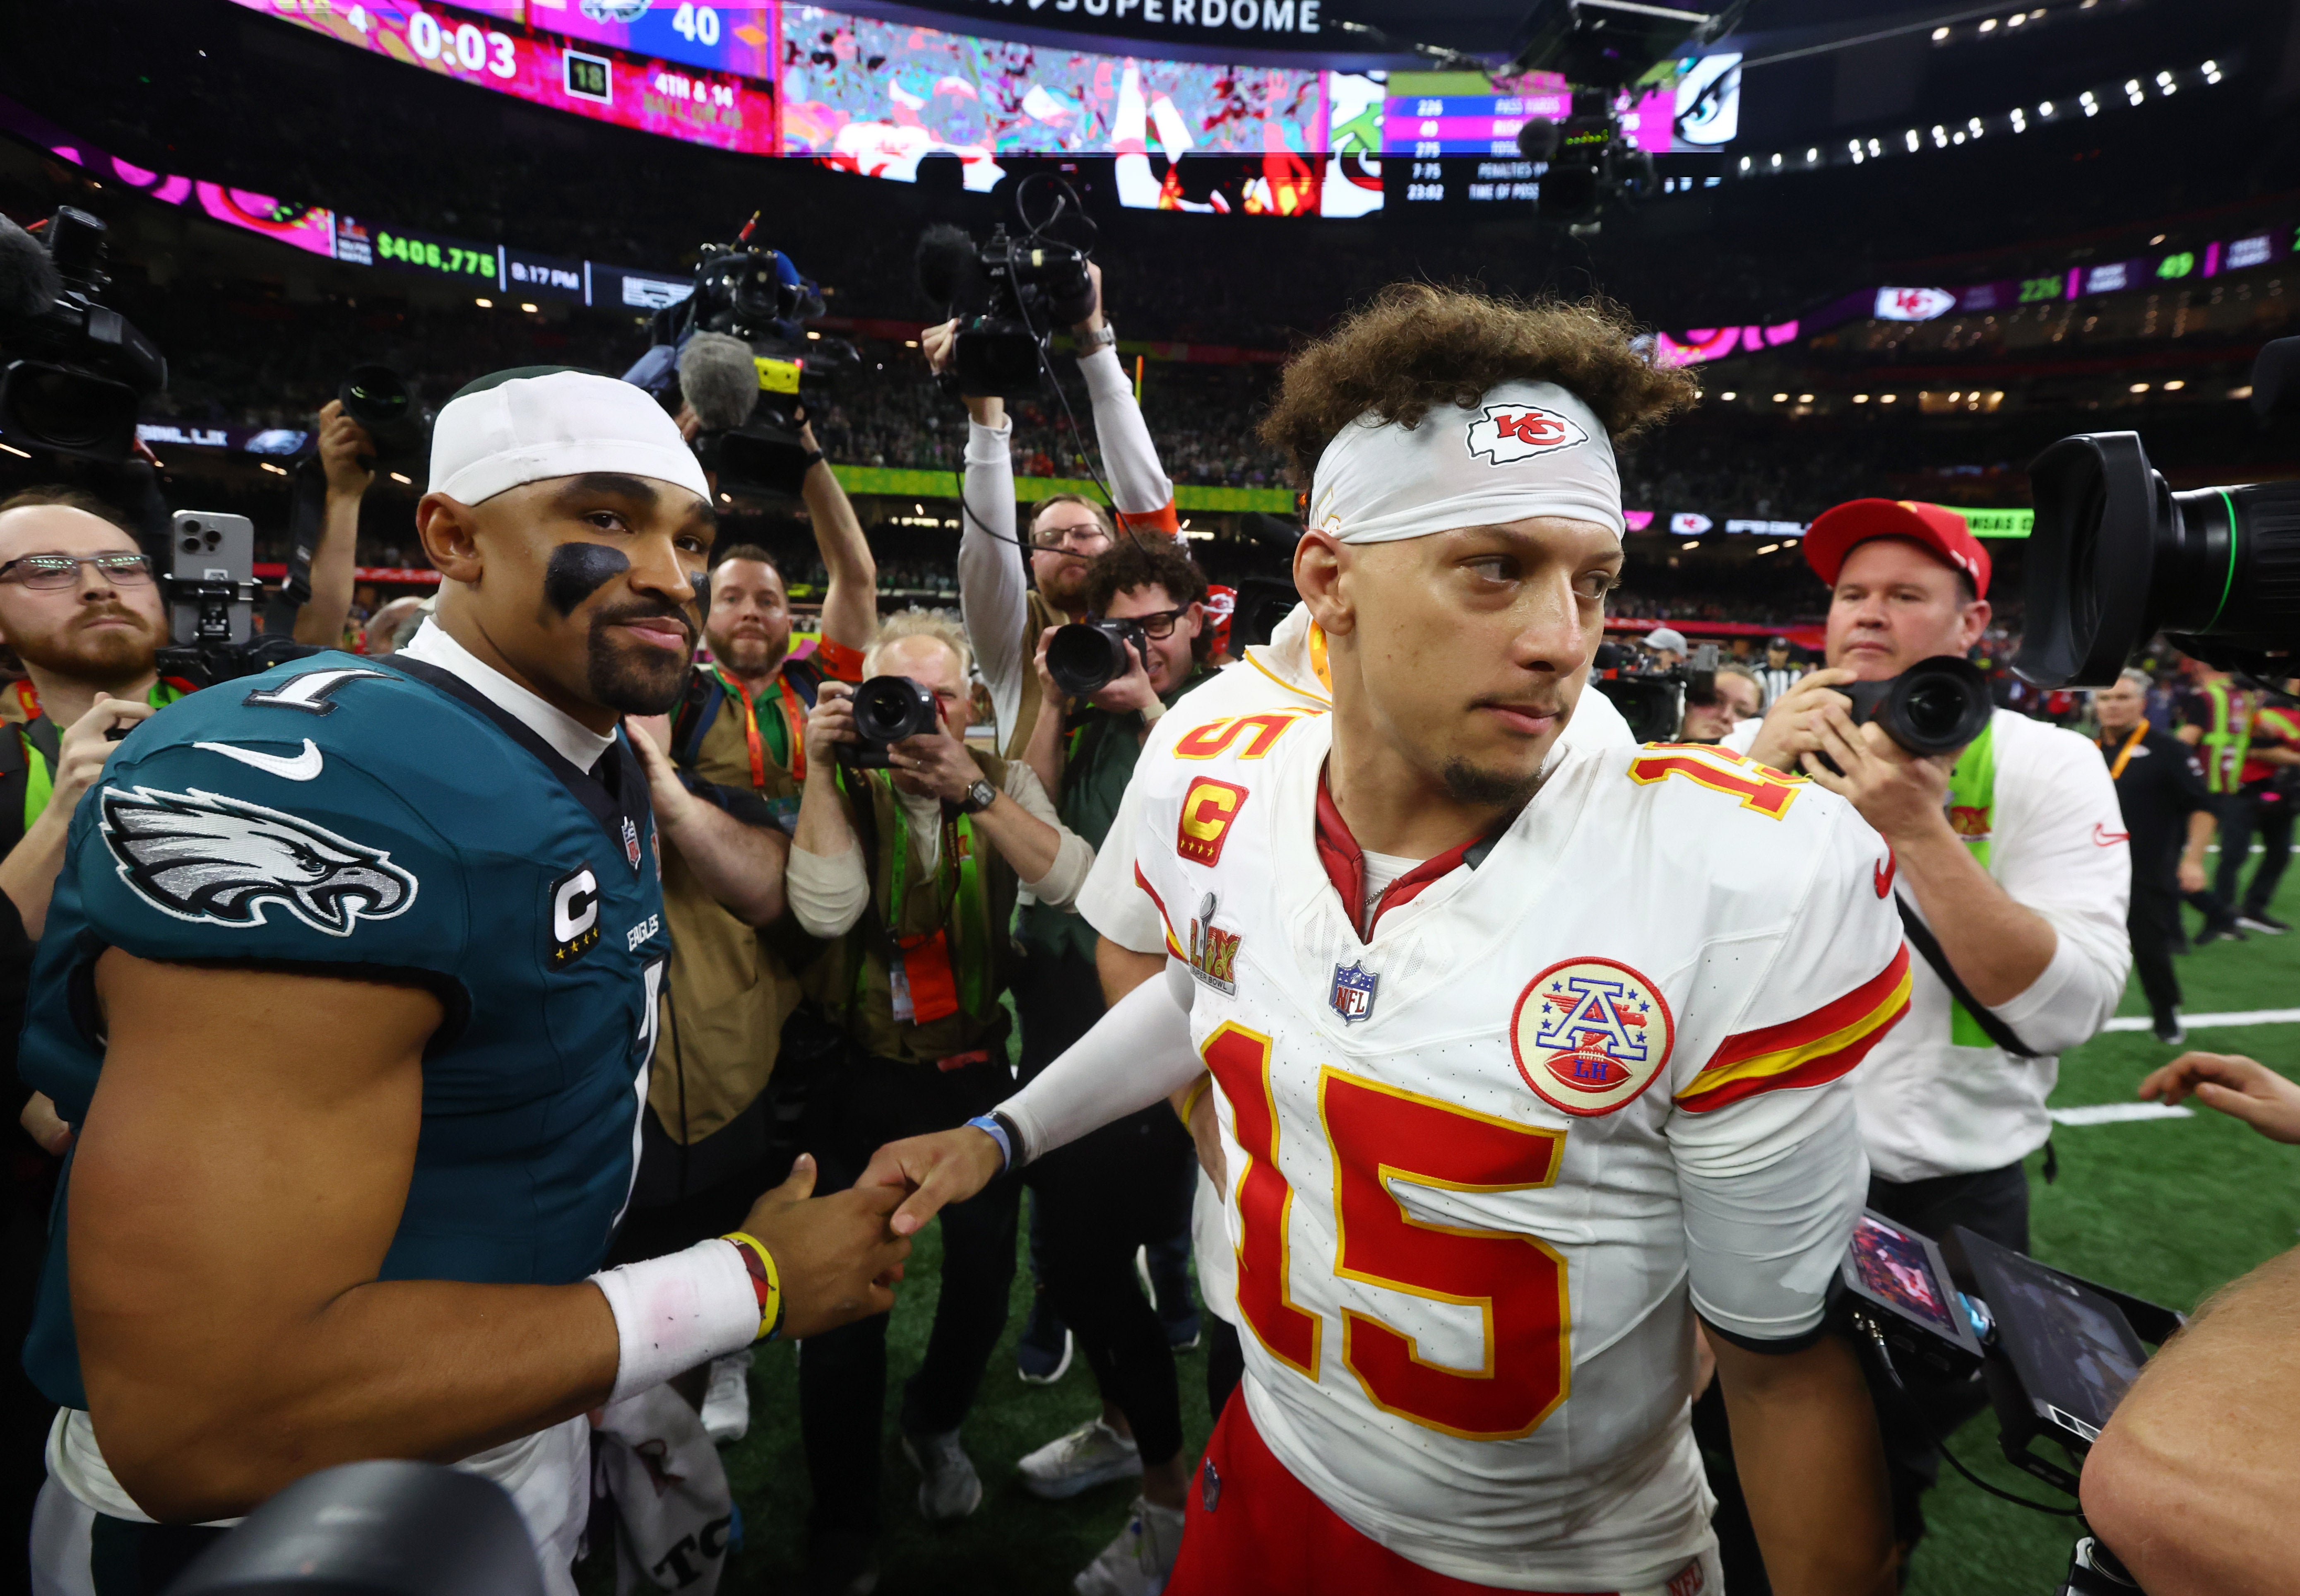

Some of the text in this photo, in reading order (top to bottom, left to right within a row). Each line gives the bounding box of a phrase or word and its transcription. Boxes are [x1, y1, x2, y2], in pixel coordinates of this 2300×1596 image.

[348, 4, 368, 33] 4
[672, 2, 720, 46] 40
[409, 11, 517, 78] 0:03
[654, 73, 734, 108] 4TH & 14
[1494, 413, 1566, 445] KC
[243, 667, 404, 717] 1
[1183, 784, 1237, 841] C
[554, 869, 597, 943] C
[626, 913, 659, 952] EAGLES
[1192, 966, 1227, 990] SUPER BOWL
[1334, 986, 1365, 1013] NFL
[1536, 977, 1647, 1061] A
[1573, 1059, 1608, 1080] LH
[1199, 1019, 1571, 1441] 15
